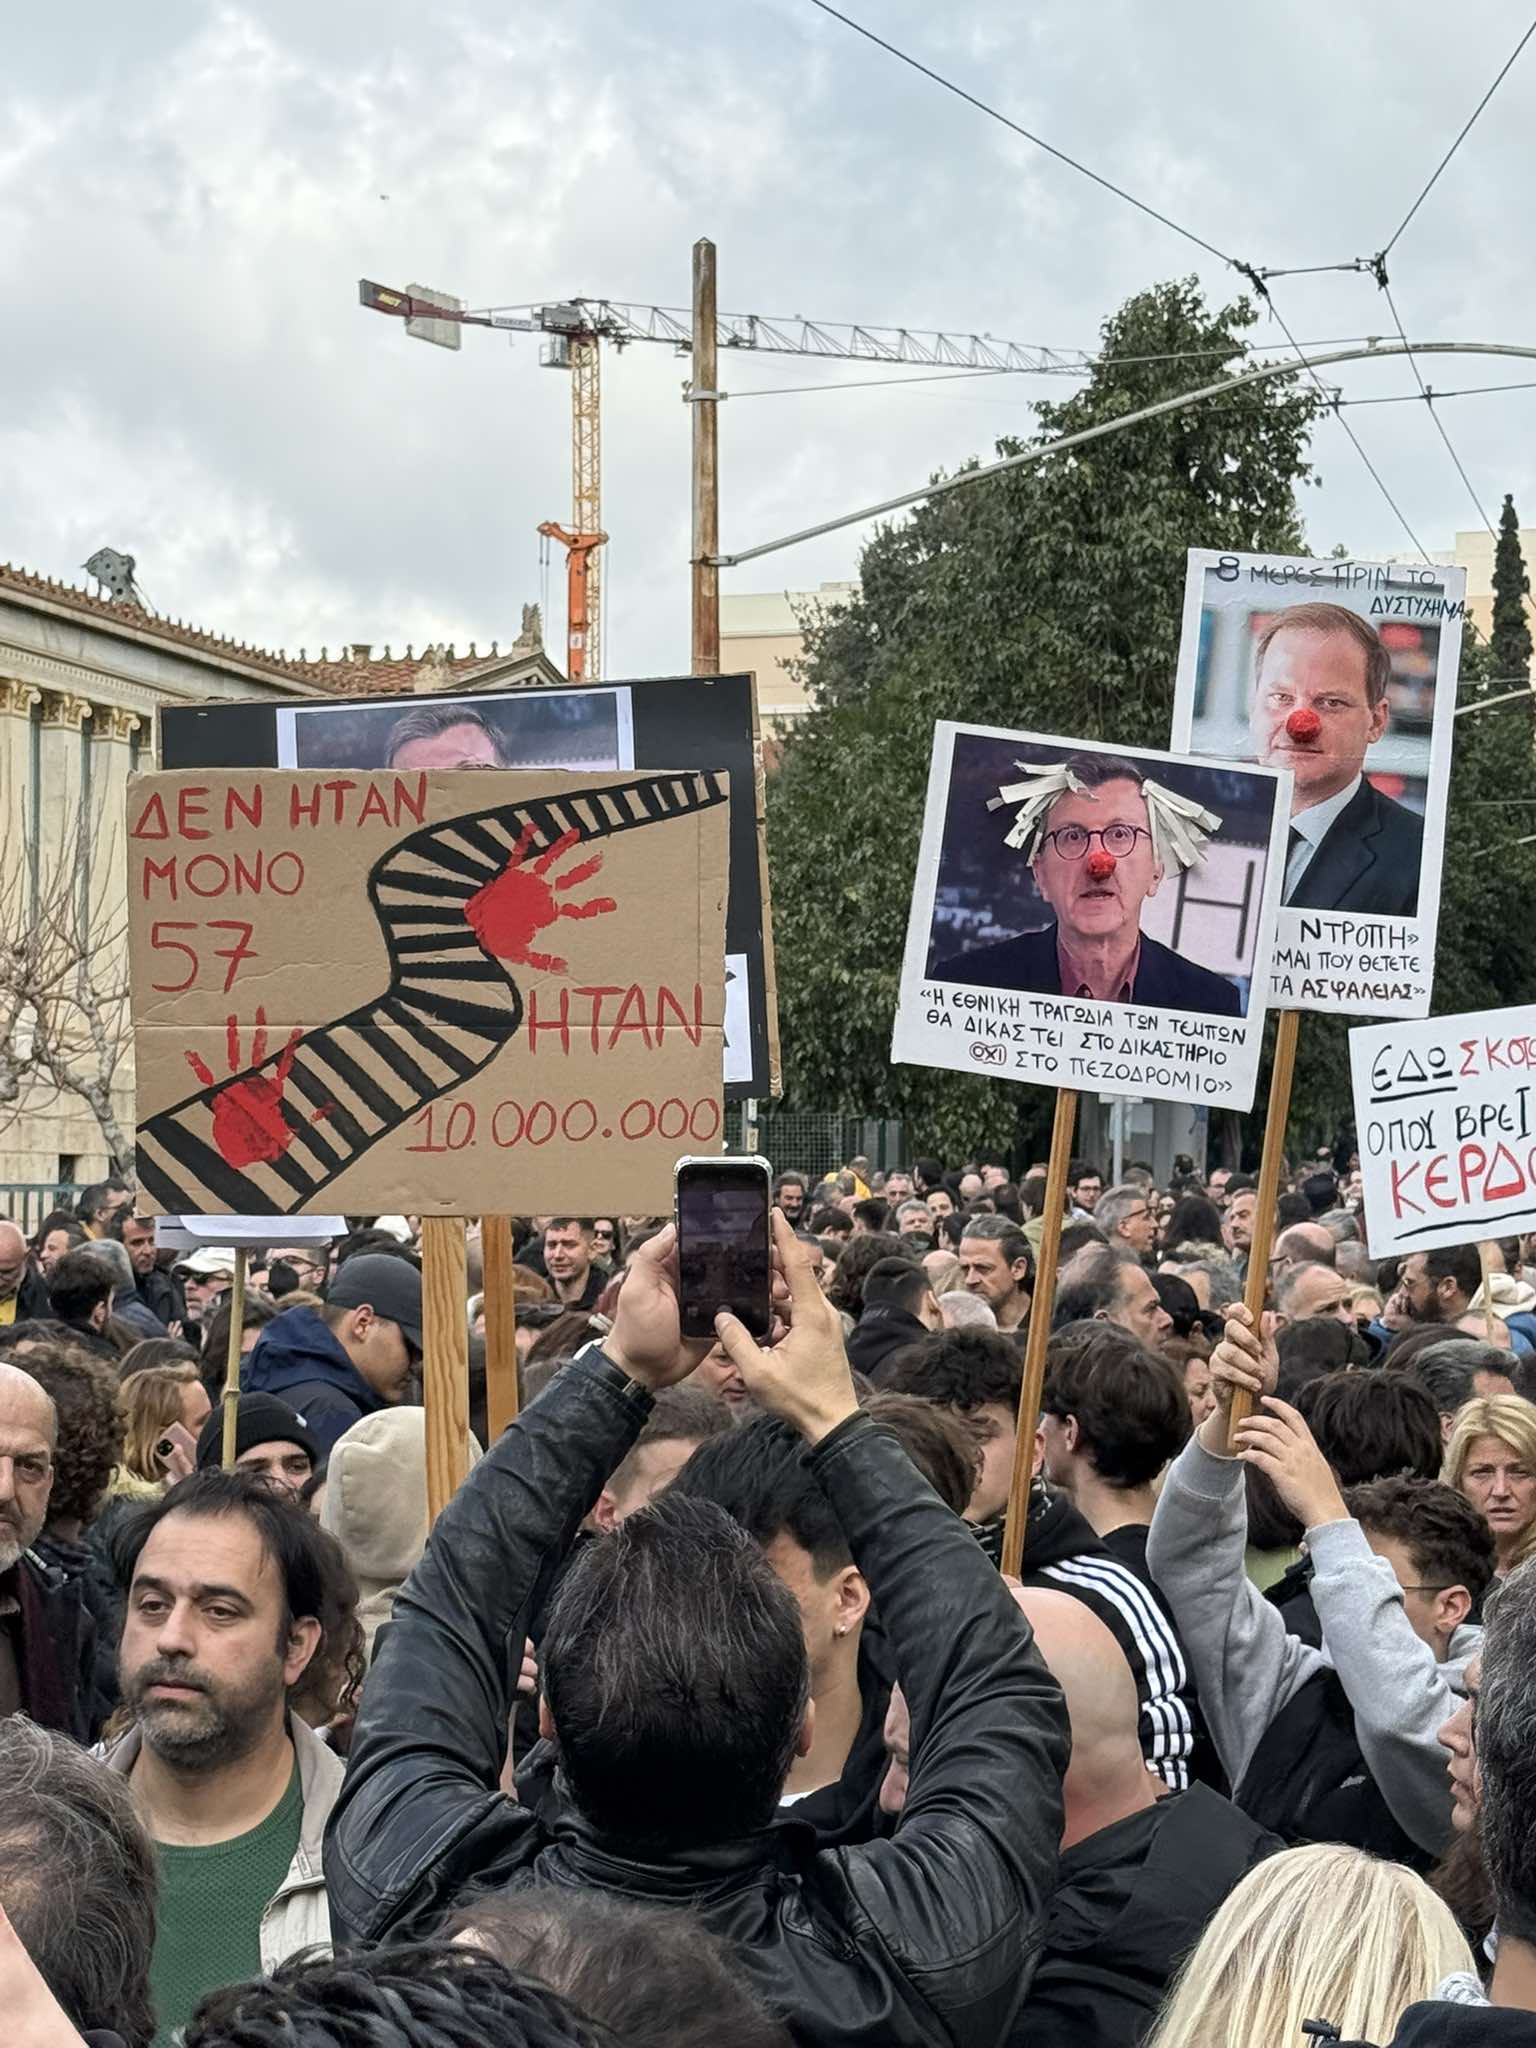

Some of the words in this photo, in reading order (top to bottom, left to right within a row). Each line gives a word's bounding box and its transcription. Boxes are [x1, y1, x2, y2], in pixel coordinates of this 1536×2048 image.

[1216, 556, 1239, 582] 8
[1332, 562, 1390, 591] ΠΡΙΝ
[1407, 569, 1436, 586] ΤΟ
[1369, 597, 1466, 623] ΔΥΣΤΥΧΗΜΑ
[130, 783, 262, 840] ΔΕΝ
[289, 772, 427, 828] ΗΤΑΝ
[142, 849, 304, 901] ΜΟΝΟ
[150, 920, 259, 993] 57
[1300, 918, 1420, 949] ΝΤΡΟΠΗ»
[1272, 949, 1311, 970] ΜΑΙ
[1318, 951, 1353, 972] ΠΟΥ
[1358, 954, 1421, 973] ΘΕΤΕΤΕ
[1301, 978, 1427, 1001] ΑΣΦΑΛΕΙΑΣ»
[528, 983, 703, 1056] ΗΤΑΝ
[926, 1009, 952, 1028] ΘΑ
[1080, 1031, 1114, 1051] ΣΤΟ
[1118, 1038, 1227, 1065] ΔΙΚΑΣΤΗΡΙΟ
[952, 994, 1020, 1017] ΕΘΝΙΚΗ
[1029, 1000, 1113, 1026] ΤΡΑΓΩΔΙΑ
[1124, 1012, 1158, 1031] ΤΩΝ
[1168, 1018, 1246, 1045] ΤΕΜΠΩΝ
[971, 1044, 1005, 1063] ΟΧΙ
[1015, 1051, 1058, 1072] ΣΤΟ
[1069, 1057, 1233, 1094] ΠΕΖΟΔΡΟΜΙΟ»
[1371, 1044, 1453, 1092] ΕΔΩ
[405, 1098, 720, 1153] 10.000.000
[1367, 1109, 1437, 1156] ΟΠΟΥ
[1455, 1086, 1532, 1142] ΒΡΕΙ
